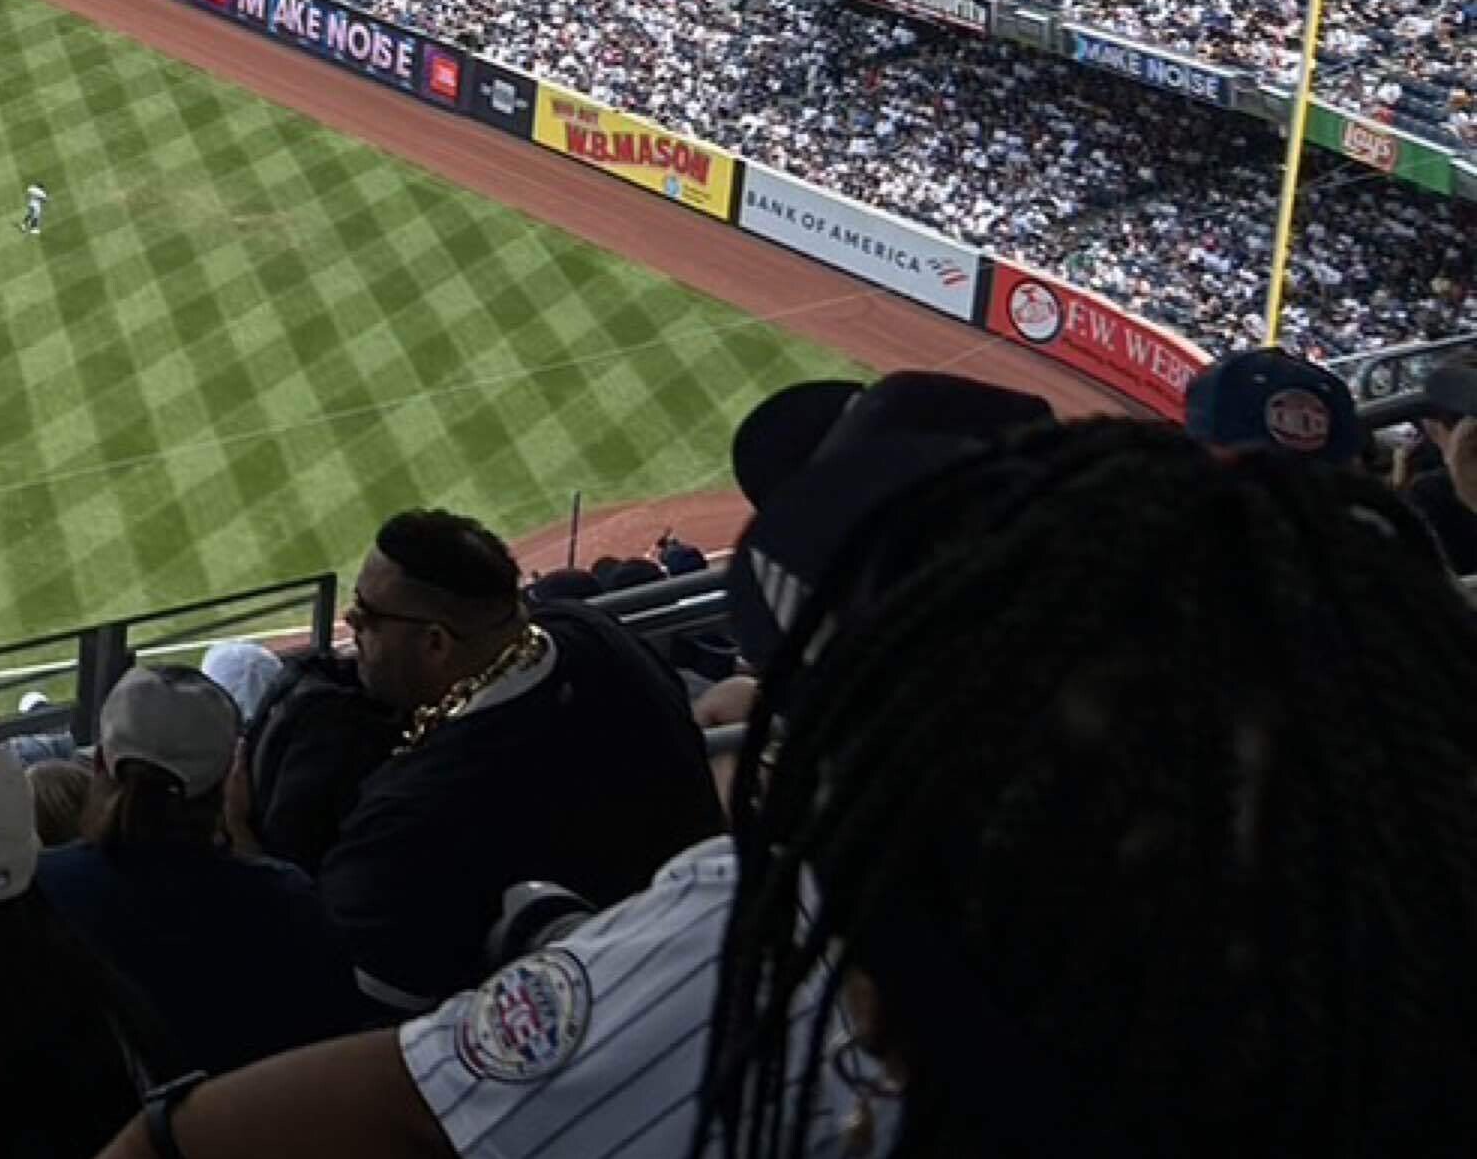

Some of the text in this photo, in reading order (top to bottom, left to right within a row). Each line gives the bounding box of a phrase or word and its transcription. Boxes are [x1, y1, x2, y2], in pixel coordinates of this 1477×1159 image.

[327, 12, 415, 80] NOISE
[1146, 57, 1221, 102] NOISE
[746, 189, 798, 225] BANK
[799, 211, 826, 235] OF
[830, 224, 922, 276] AMERICA
[1065, 300, 1118, 353] F.W.
